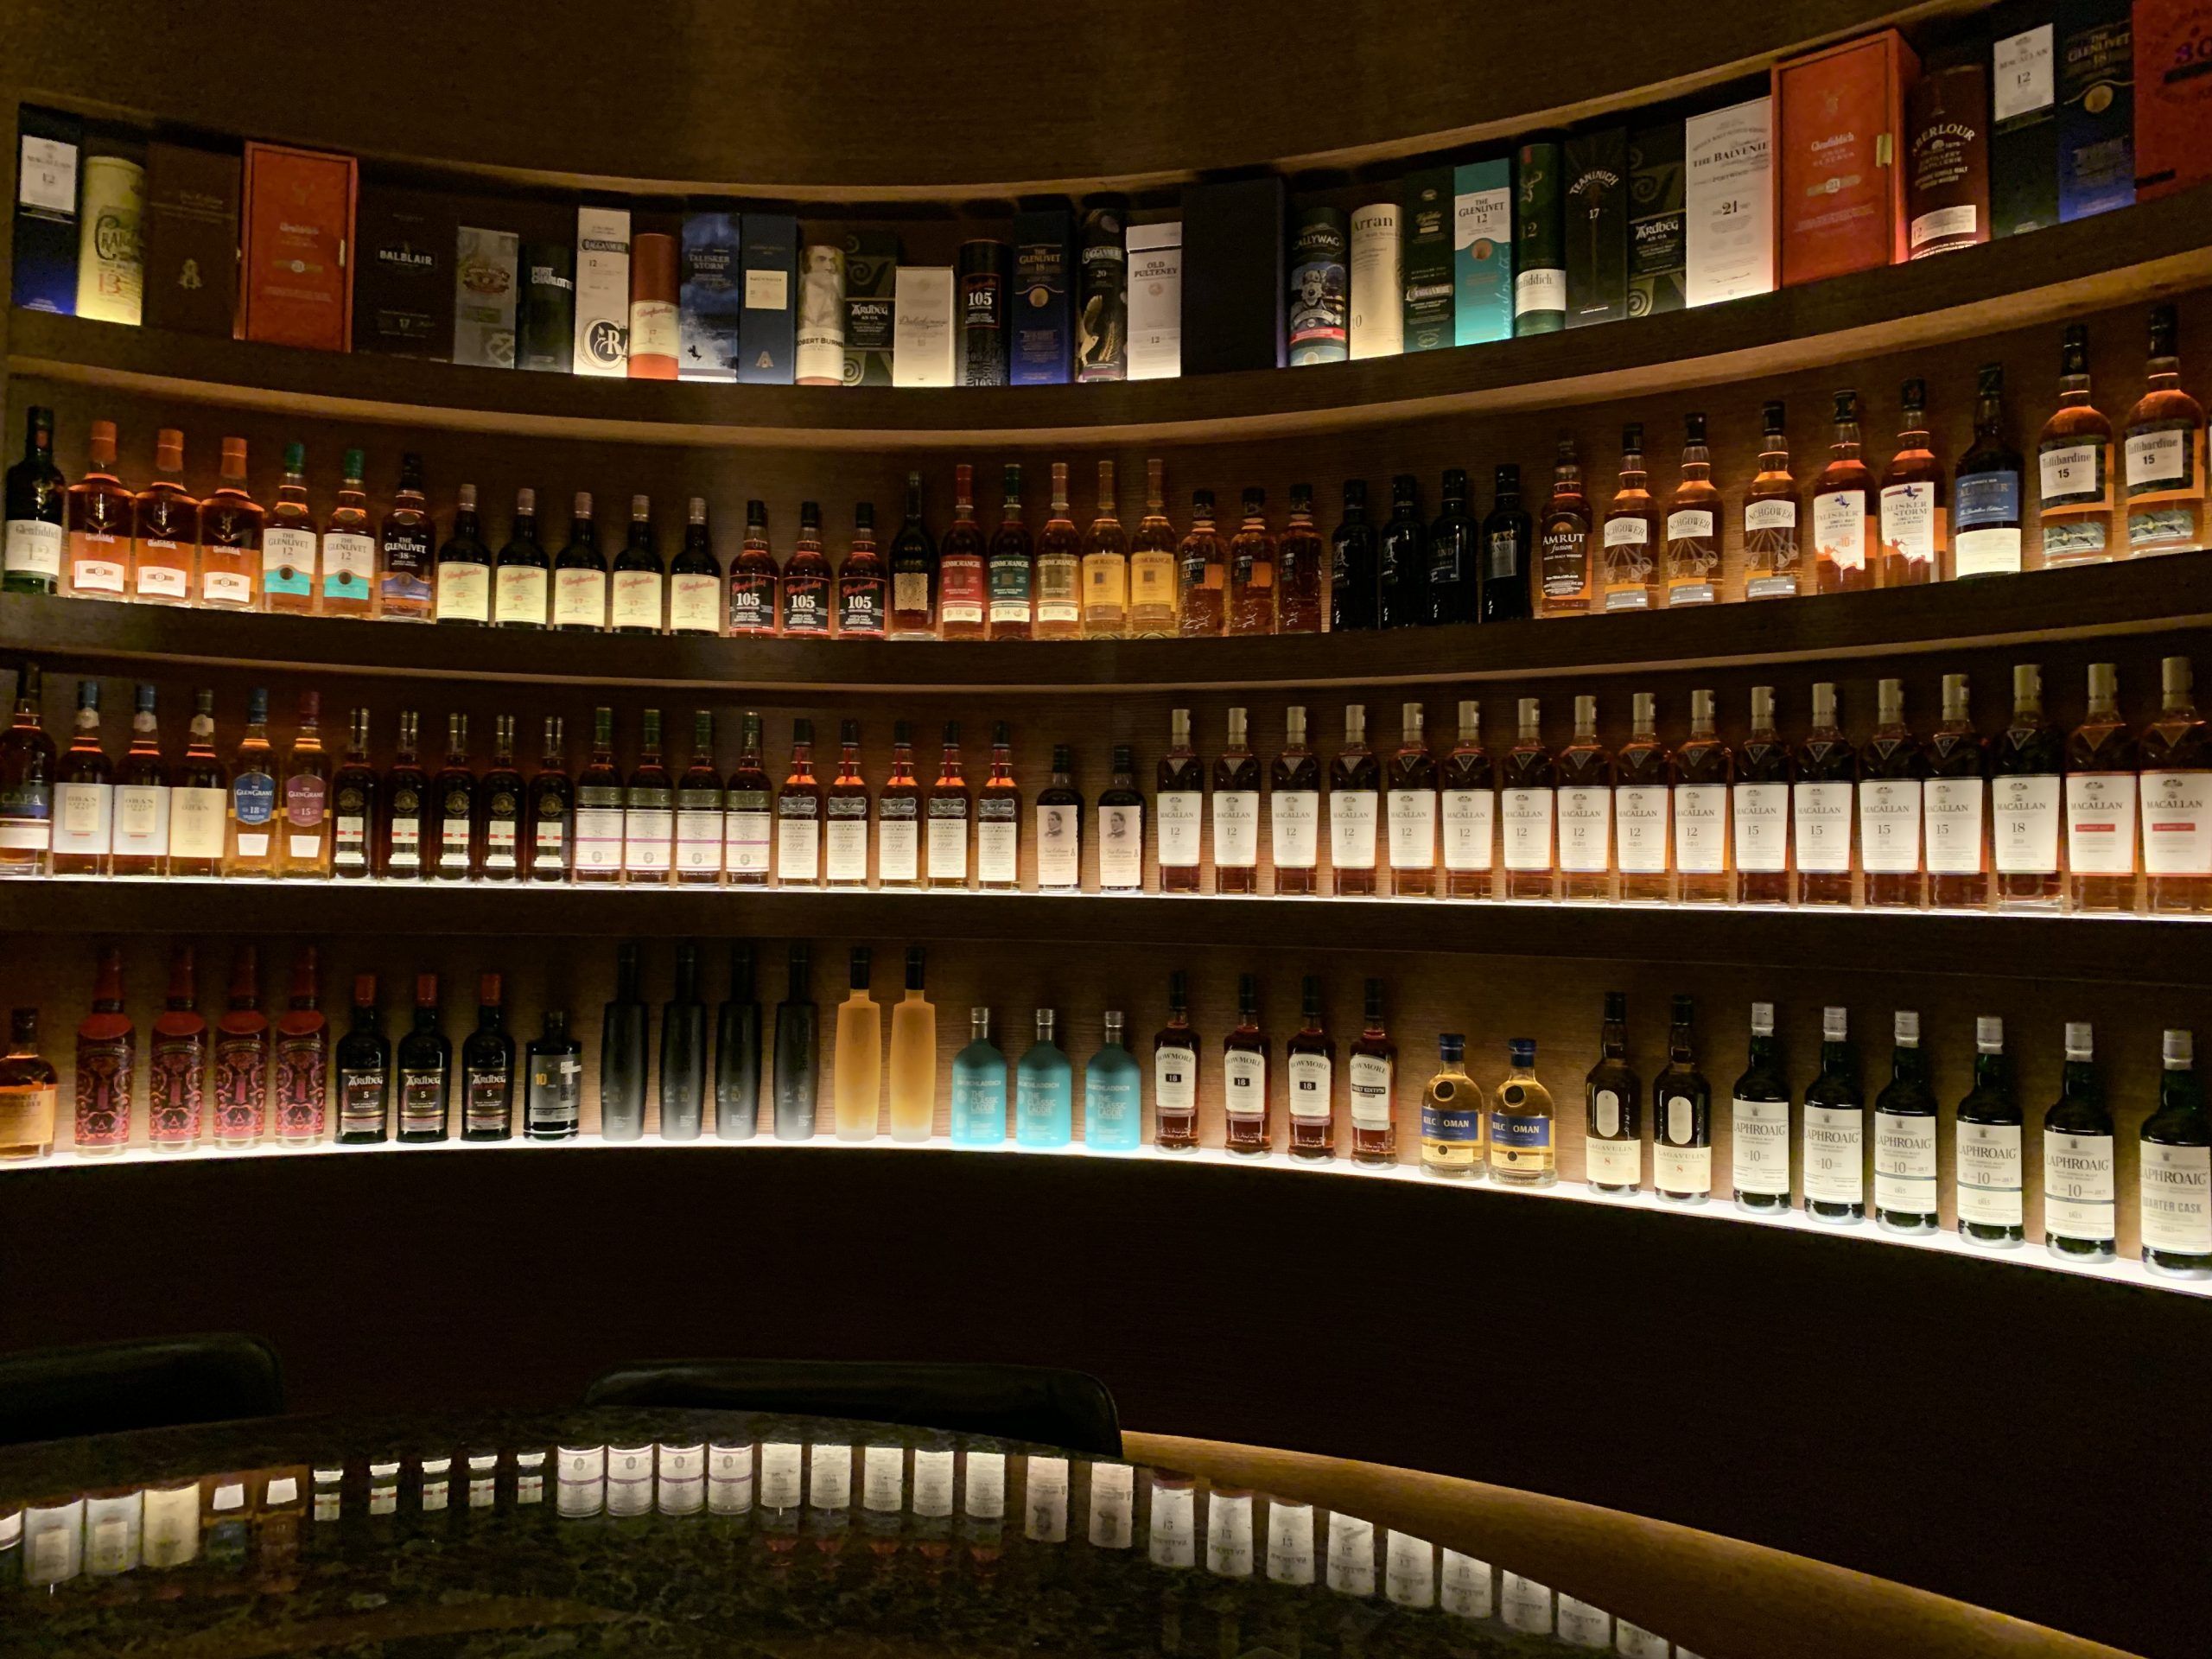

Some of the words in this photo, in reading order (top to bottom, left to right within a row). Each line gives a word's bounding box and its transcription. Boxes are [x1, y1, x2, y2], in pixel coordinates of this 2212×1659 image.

[2018, 72, 2031, 85] 12
[1713, 142, 1766, 163] BALVENIE
[1569, 170, 1619, 196] TEANINICH
[1459, 201, 1504, 218] GLENLIVET
[1589, 207, 1600, 219] 17
[1722, 200, 1738, 215] 21
[1477, 213, 1487, 224] 12
[1635, 219, 1679, 240] Ardbeg
[379, 249, 433, 266] BALBLAIR
[1147, 261, 1165, 270] OLD
[1135, 267, 1178, 277] PULTENEY
[968, 291, 992, 306] 105
[850, 303, 888, 315] Ardbeg
[2128, 439, 2178, 454] Tullibardine
[2043, 453, 2091, 468] Tullibardine
[2144, 454, 2155, 464] 15
[2058, 468, 2069, 478] 15
[1893, 508, 1928, 517] STORM
[269, 537, 308, 549] GLENLIVET
[1542, 533, 1586, 546] AMRUT
[283, 547, 293, 556] 12
[327, 543, 366, 554] GLENLIVET
[385, 542, 426, 554] GLENLIVET
[340, 551, 351, 560] 12
[736, 593, 760, 607] 105
[791, 594, 816, 608] 105
[848, 595, 872, 609] 105
[1864, 804, 1909, 813] MACALLAN
[1926, 804, 1968, 812] MACALLAN
[1996, 802, 2046, 810] MACALLAN
[2146, 800, 2202, 809] MACALLAN
[250, 806, 259, 815] 18
[1446, 810, 1485, 819] MACALLAN
[1505, 810, 1542, 818] MACALLAN
[1561, 810, 1601, 818] MACALLAN
[1618, 809, 1657, 817] MACALLAN
[1676, 809, 1715, 817] MACALLAN
[1797, 806, 1841, 815] MACALLAN
[1170, 827, 1181, 836] 12
[1227, 827, 1237, 836] 12
[1287, 827, 1297, 836] 12
[1344, 828, 1354, 836] 12
[1402, 827, 1412, 836] 12
[1459, 828, 1471, 837] 12
[1516, 827, 1528, 836] 12
[1573, 828, 1585, 836] 12
[1629, 827, 1640, 836] 12
[1686, 827, 1698, 836] 12
[1747, 825, 1759, 835] 15
[1810, 824, 1822, 835] 15
[1878, 824, 1891, 835] 15
[1936, 824, 1948, 835] 15
[2012, 822, 2025, 833] 18
[347, 1074, 384, 1086] Ardbeg
[405, 1074, 442, 1086] Ardbeg
[472, 1074, 507, 1085] Ardbeg
[534, 1073, 547, 1085] 10
[1604, 1157, 1611, 1166] 8
[1749, 1150, 1760, 1162] 10
[1675, 1164, 1683, 1173] 8
[1821, 1158, 1832, 1170] 10
[1893, 1161, 1906, 1173] 10
[2046, 1154, 2110, 1172] LAPHROAIG
[1977, 1172, 1990, 1185] 10
[2068, 1184, 2082, 1198] 10
[2177, 1202, 2202, 1214] CASK
